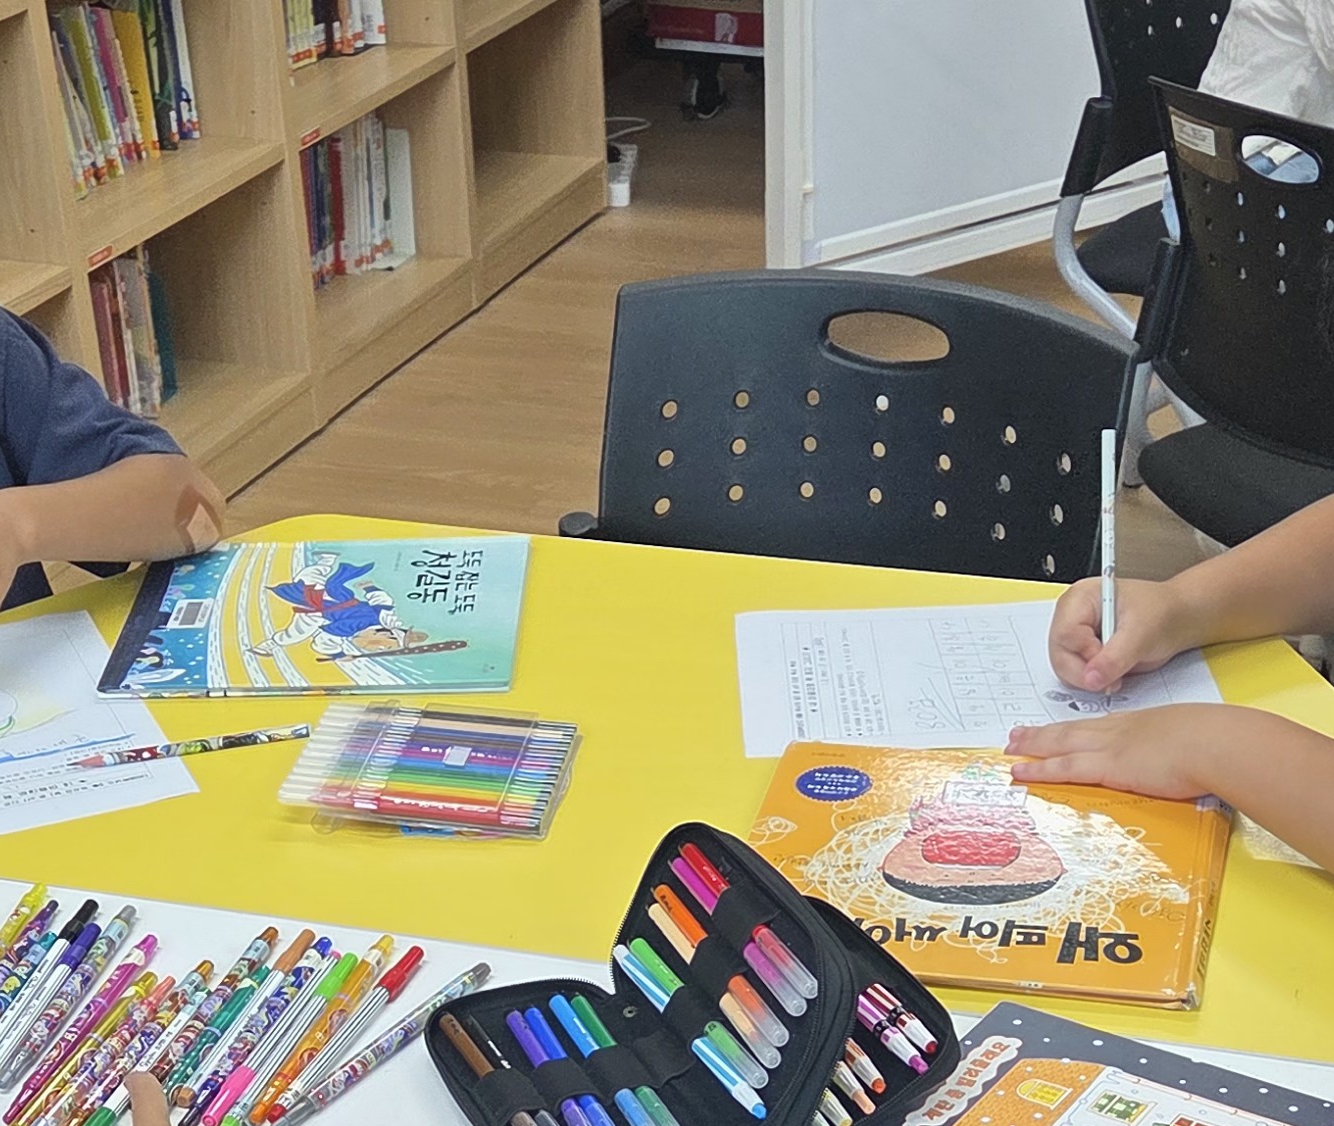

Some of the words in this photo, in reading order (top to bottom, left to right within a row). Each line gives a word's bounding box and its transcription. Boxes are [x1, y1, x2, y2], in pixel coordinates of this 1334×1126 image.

[406, 549, 458, 604] 청길동
[454, 570, 479, 591] 잡는
[448, 594, 476, 615] 도둑
[958, 915, 1049, 947] 띄어
[1056, 921, 1144, 965] 왜
[921, 1098, 954, 1121] 계란
[953, 1041, 1011, 1088] 빌려줄래요
